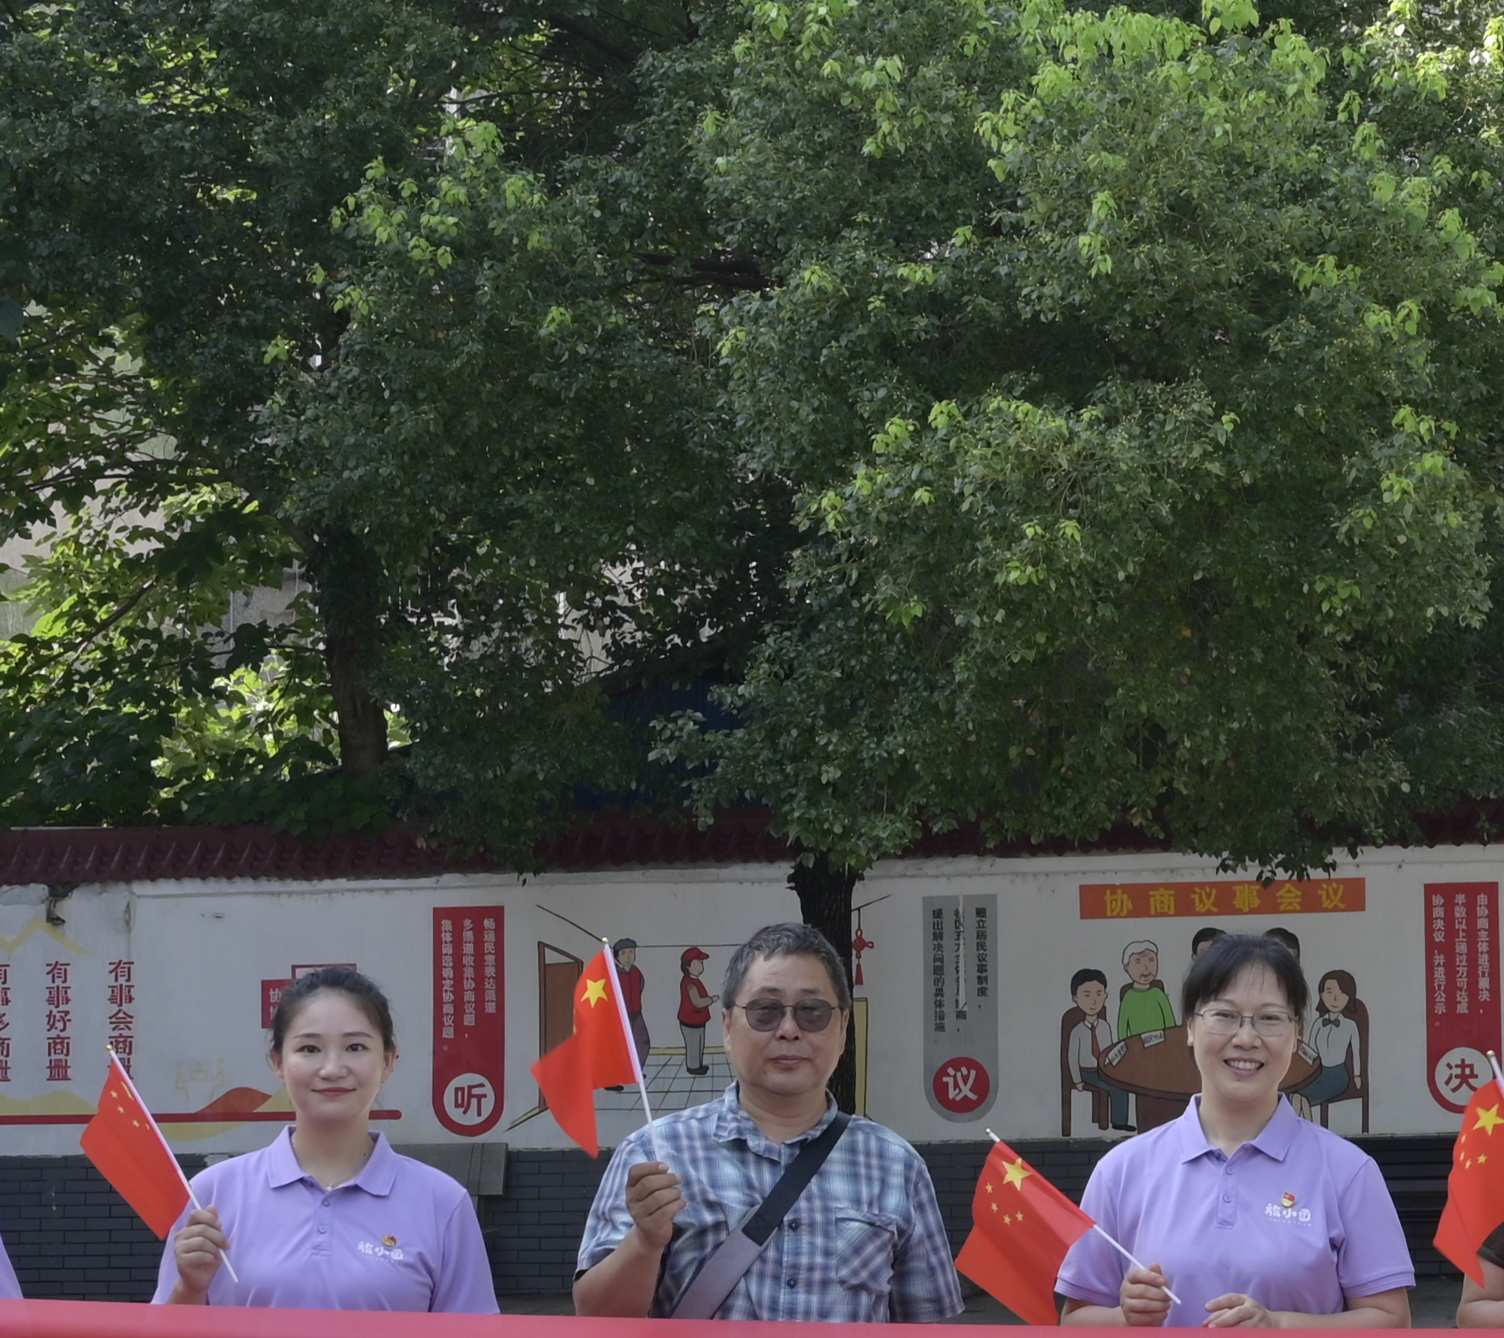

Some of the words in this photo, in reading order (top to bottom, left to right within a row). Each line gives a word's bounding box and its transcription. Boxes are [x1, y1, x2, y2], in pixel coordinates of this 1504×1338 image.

[1103, 883, 1346, 917] 协商议事会议
[1454, 893, 1469, 1014] 半数以上通过方可达成
[45, 960, 72, 1082] 有事好商量
[942, 1066, 979, 1102] 议
[1444, 1057, 1479, 1094] 决
[454, 1082, 488, 1118] 听
